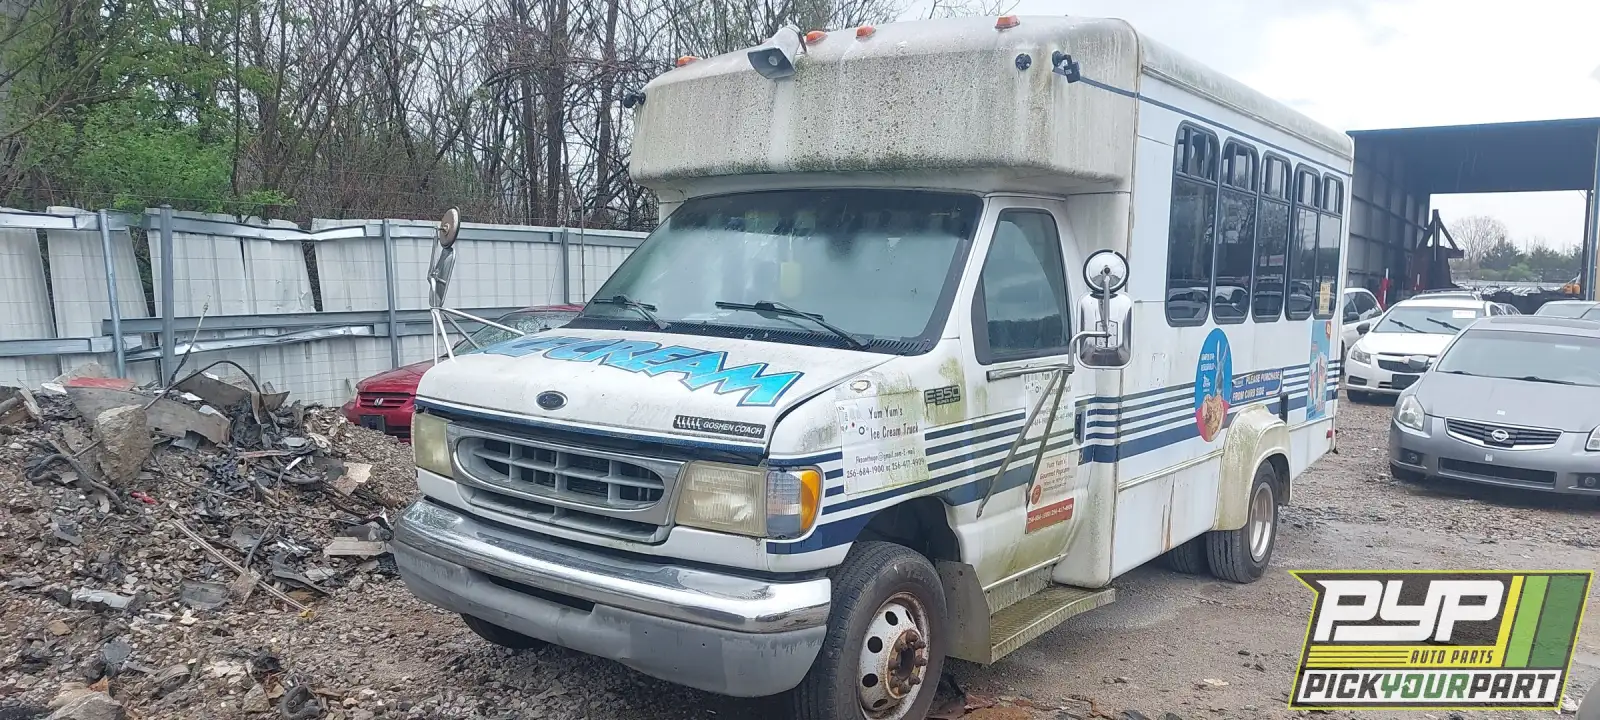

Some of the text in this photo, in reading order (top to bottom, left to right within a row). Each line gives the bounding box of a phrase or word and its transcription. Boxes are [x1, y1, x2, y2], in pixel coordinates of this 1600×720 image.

[542, 338, 805, 408] CREAM
[1246, 374, 1260, 385] PLEASE
[1260, 371, 1281, 382] PURCHASE
[1233, 390, 1245, 402] FROM
[868, 404, 903, 420] Yum Yum's
[703, 421, 763, 435] GOSHEN COACH
[870, 421, 919, 440] Ice Cream Truck
